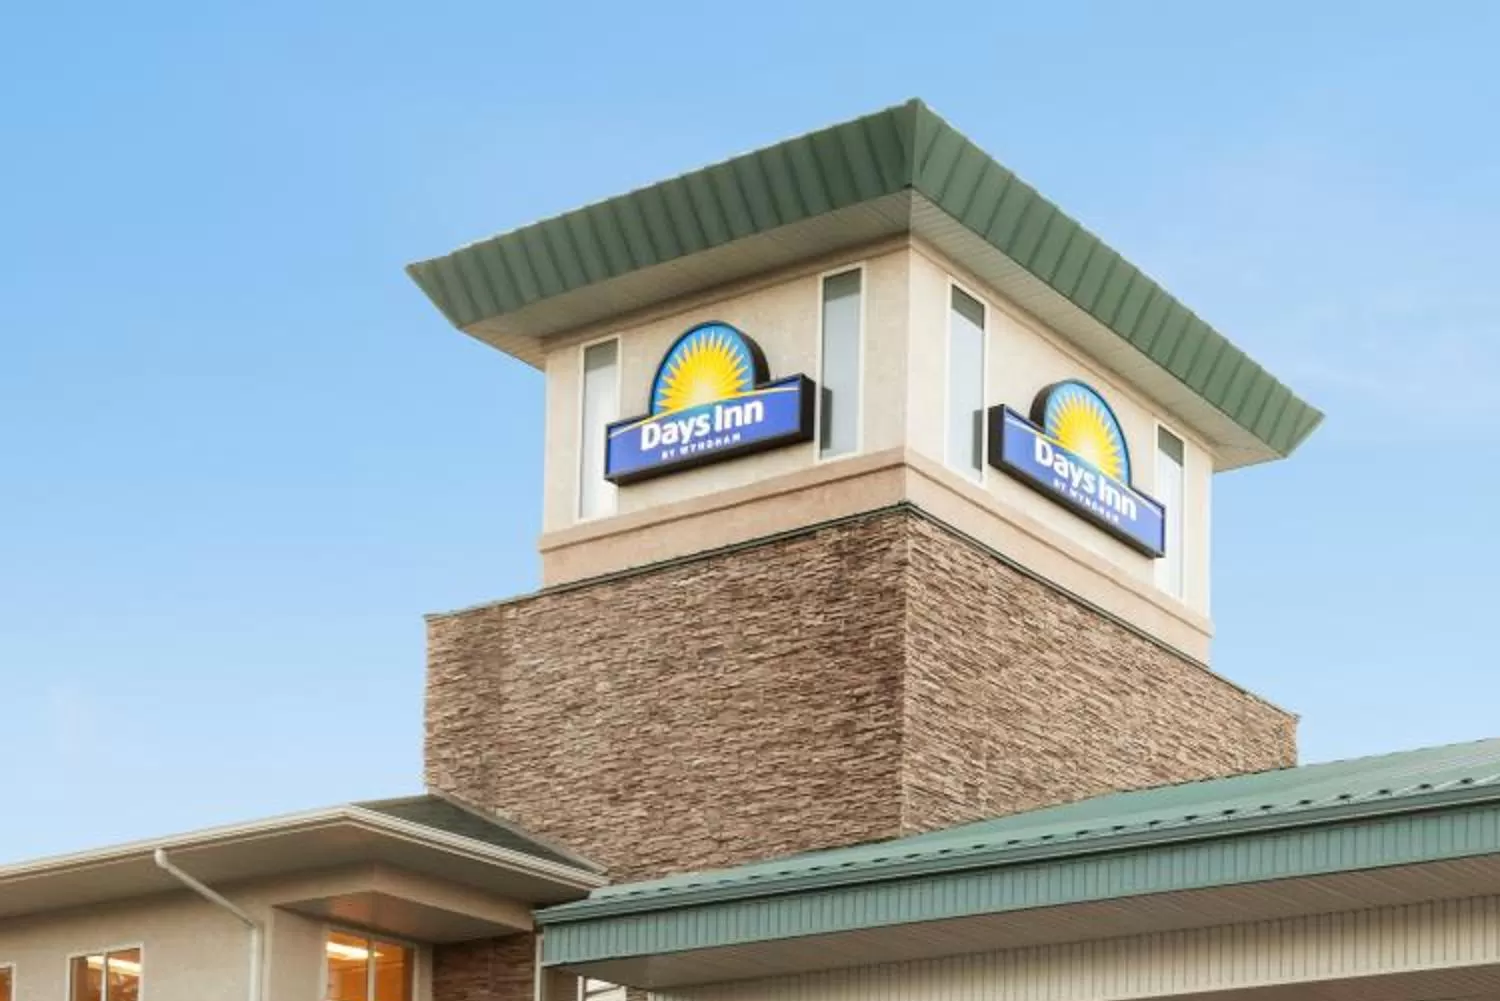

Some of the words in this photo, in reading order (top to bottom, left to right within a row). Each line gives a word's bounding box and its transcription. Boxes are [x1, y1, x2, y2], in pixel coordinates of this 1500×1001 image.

[641, 413, 710, 450] Days
[715, 400, 764, 432] Inn
[1035, 436, 1095, 494] Days
[1099, 475, 1137, 521] Inn
